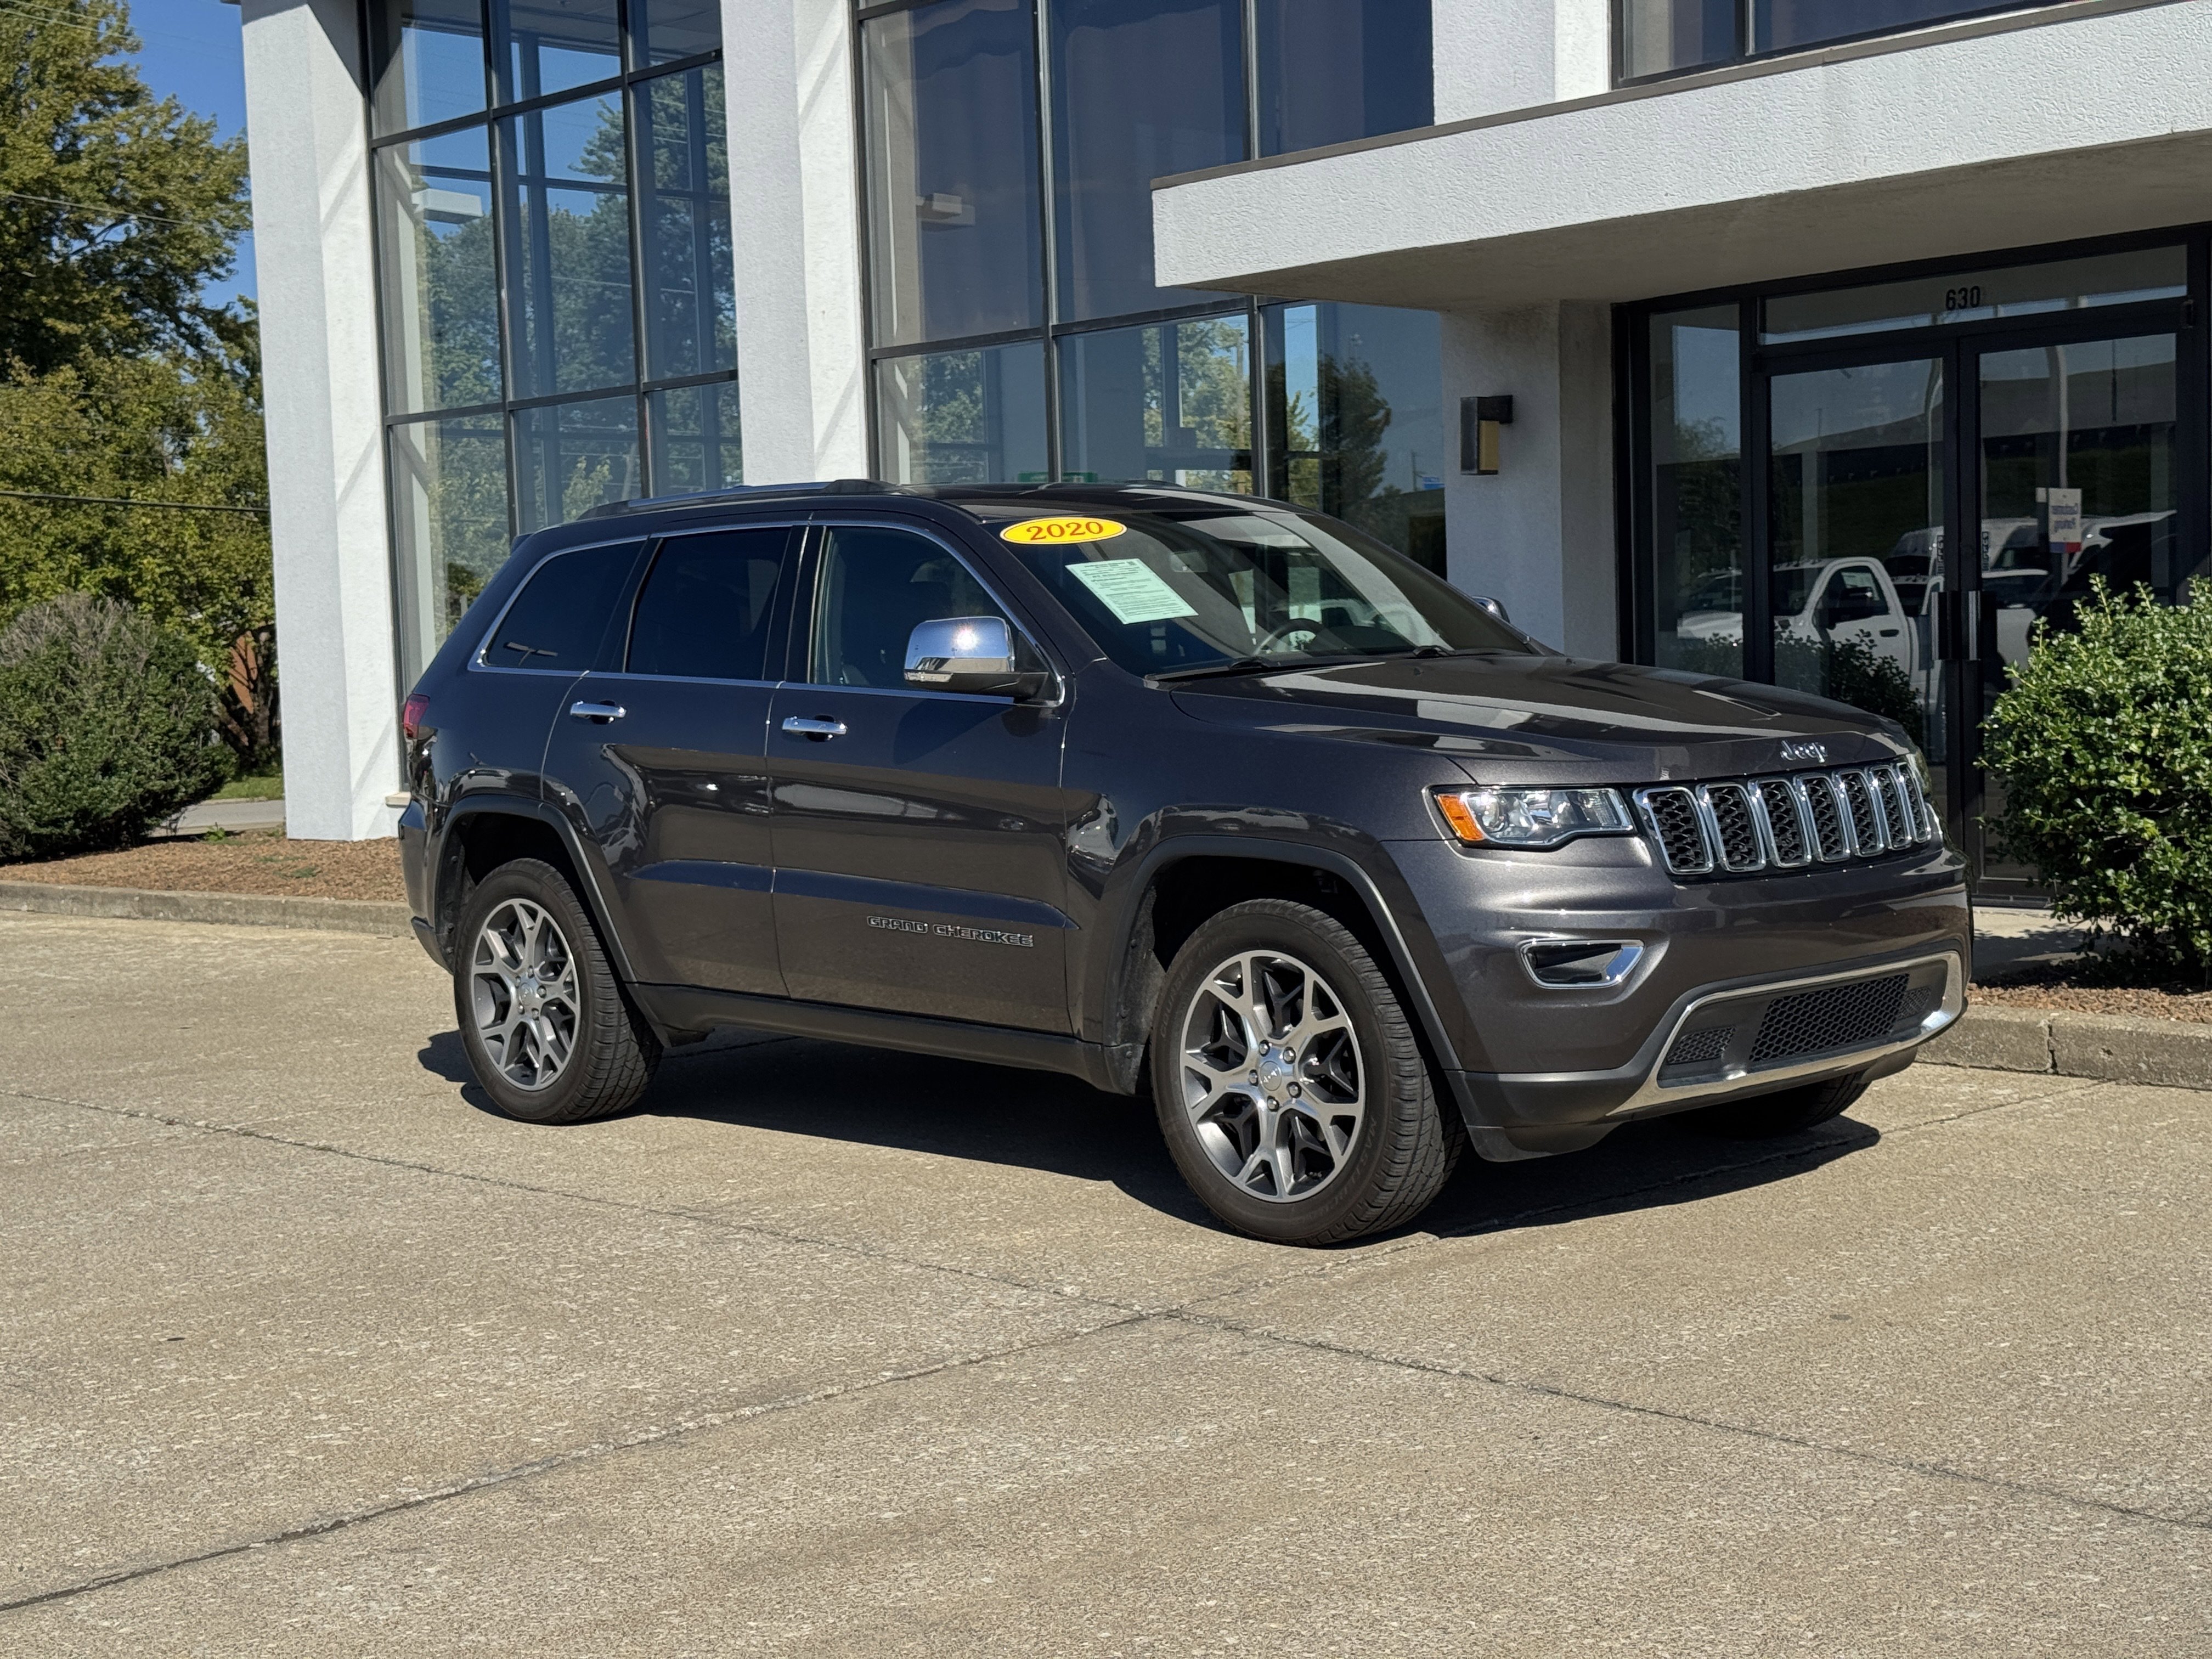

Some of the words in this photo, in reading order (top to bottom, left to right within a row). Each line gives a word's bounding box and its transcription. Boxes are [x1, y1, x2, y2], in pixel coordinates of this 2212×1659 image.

[1945, 285, 1981, 311] 630
[1026, 521, 1104, 540] 2020
[1780, 740, 1829, 763] Jeep
[867, 916, 928, 933] GRAND
[933, 924, 1034, 947] CHEROKEE
